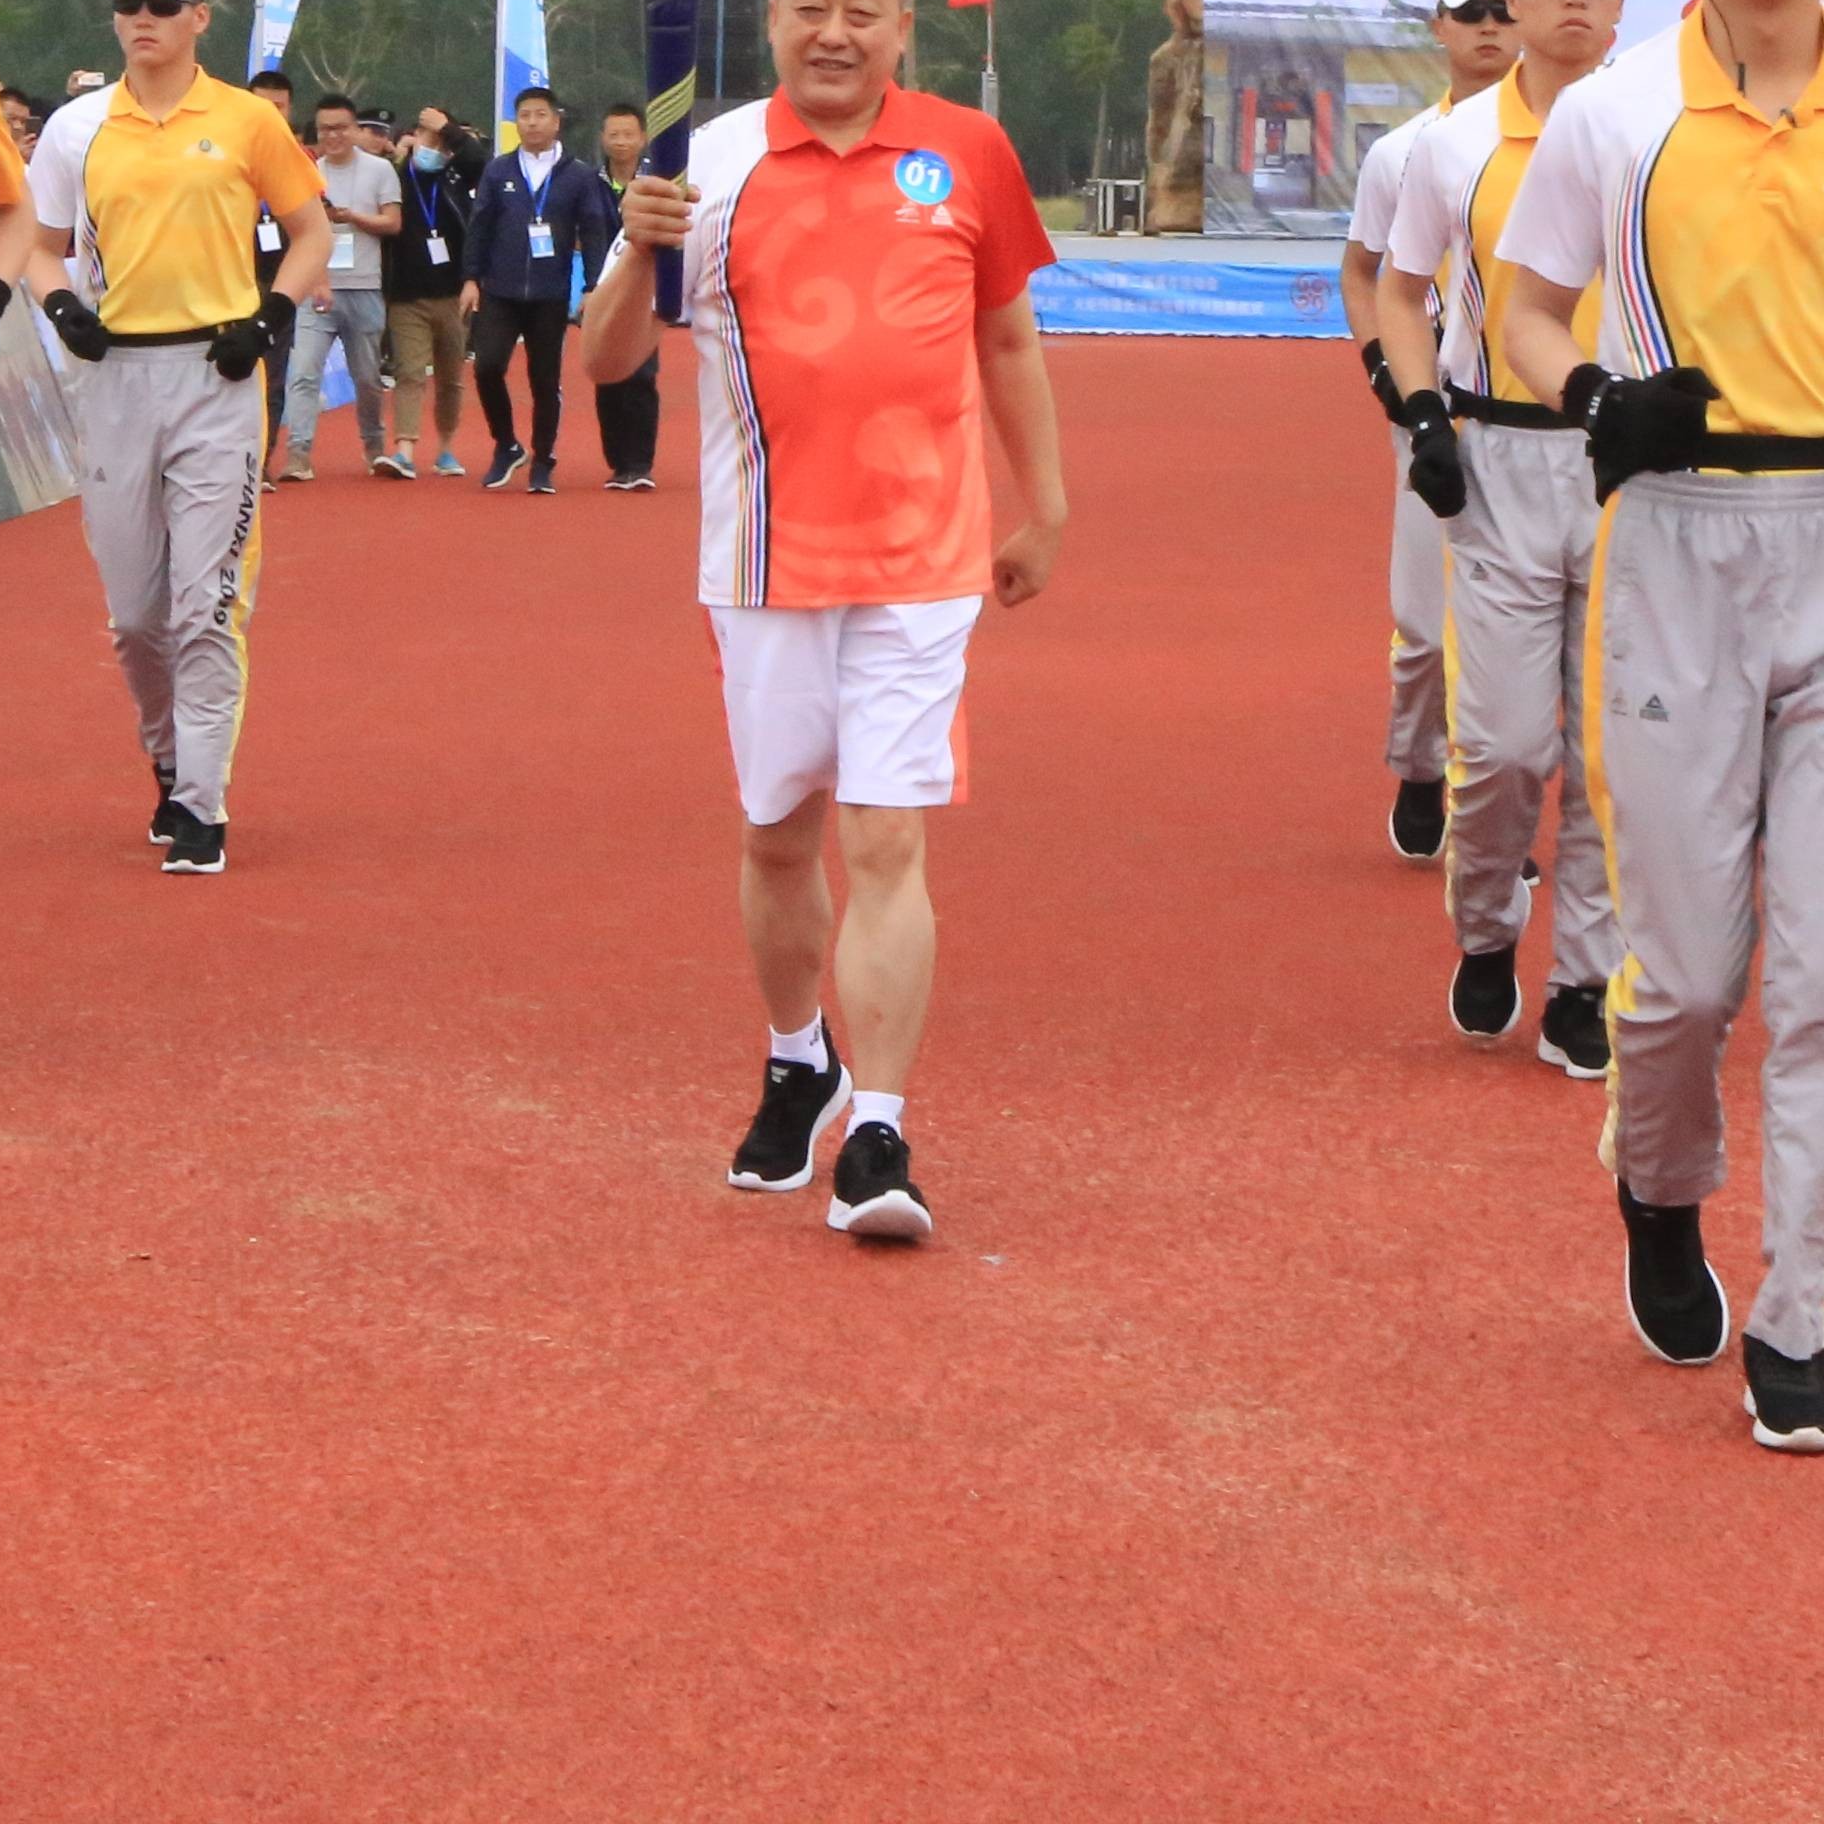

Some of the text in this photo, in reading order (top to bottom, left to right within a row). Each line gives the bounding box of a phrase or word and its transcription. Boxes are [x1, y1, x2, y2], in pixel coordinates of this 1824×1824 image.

[904, 160, 942, 194] 01
[214, 452, 258, 626] SHANXI 2019
